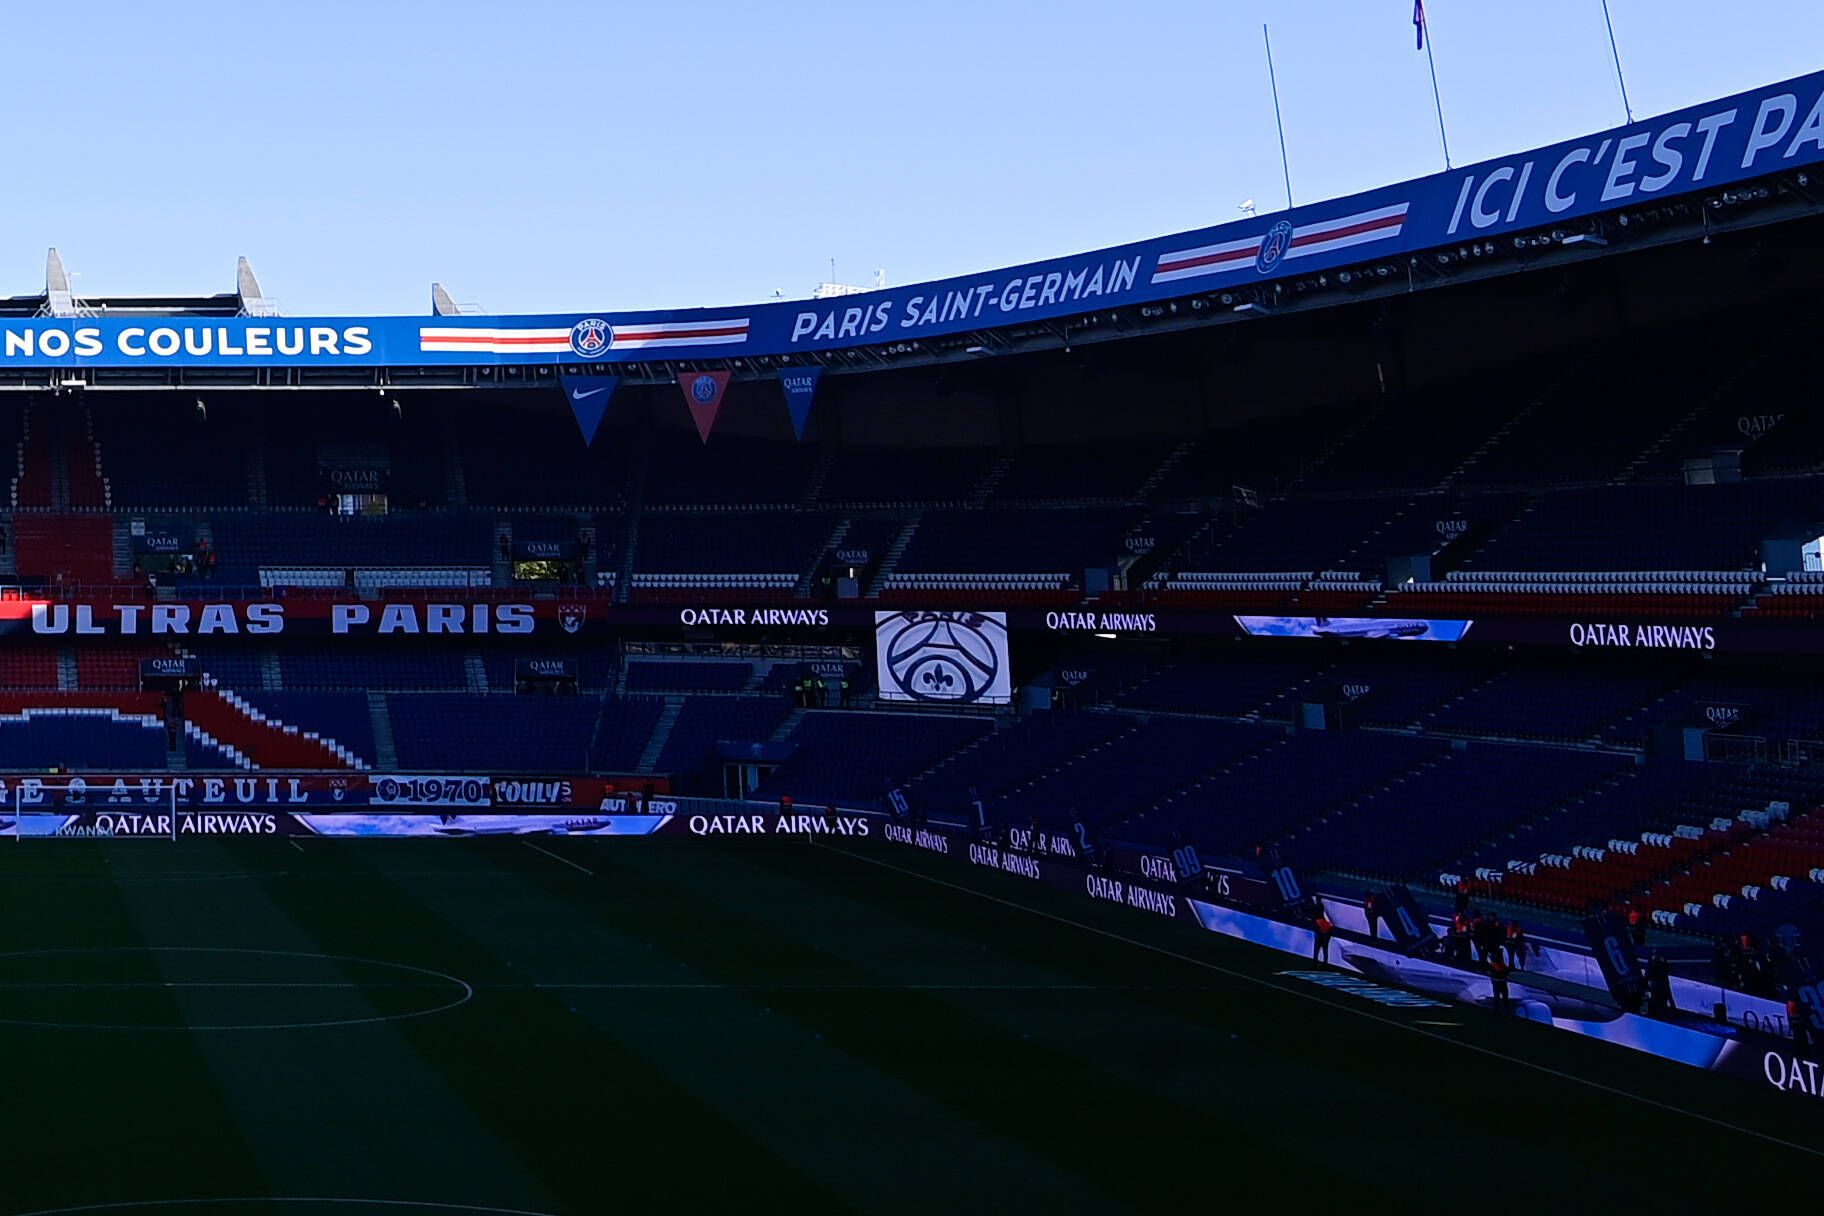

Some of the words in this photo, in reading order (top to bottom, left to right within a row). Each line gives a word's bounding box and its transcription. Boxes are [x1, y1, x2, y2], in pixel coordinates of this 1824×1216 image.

[1447, 162, 1533, 234] ICI
[1544, 109, 1738, 214] C'EST
[791, 301, 889, 343] PARIS
[901, 256, 1141, 328] SAINT-GERMAIN
[5, 327, 103, 357] NOS
[117, 326, 372, 357] COULEURS
[784, 377, 812, 389] QATAR
[331, 470, 378, 484] QATAR
[1436, 520, 1468, 535] QATAR
[147, 537, 178, 548] QATAR
[527, 543, 560, 554] QATAR
[1125, 537, 1156, 551] QATAR
[836, 550, 868, 560] QATAR
[32, 604, 284, 634] ULTRAS
[332, 604, 535, 634] PARIS
[680, 608, 747, 626] QATAR
[751, 609, 829, 626] AIRWAYS
[1046, 611, 1097, 631] QATAR
[1100, 613, 1157, 632] AIRWAYS
[1569, 623, 1631, 647] QATAR
[1635, 625, 1715, 650] AIRWAYS
[153, 659, 185, 670] QATAR
[530, 660, 564, 672] QATAR
[812, 663, 844, 675] QATAR
[108, 778, 310, 804] AUTEUIL
[407, 779, 483, 803] 1970
[887, 788, 910, 815] 15
[96, 815, 171, 835] QATAR
[181, 814, 276, 835] AIRWAYS
[689, 815, 766, 836] QATAR
[776, 815, 870, 837] AIRWAYS
[885, 823, 912, 845] QATAR
[915, 829, 948, 854] AIRWAYS
[1010, 828, 1046, 851] QATR
[969, 843, 999, 869] QATAR
[1002, 850, 1040, 879] AIRWAYS
[1173, 844, 1201, 880] 99
[1271, 866, 1302, 902] 10
[1086, 873, 1123, 904] QATAR
[1127, 884, 1176, 919] AIRWAYS
[1604, 935, 1629, 975] 6
[1763, 1050, 1824, 1098] QAT
